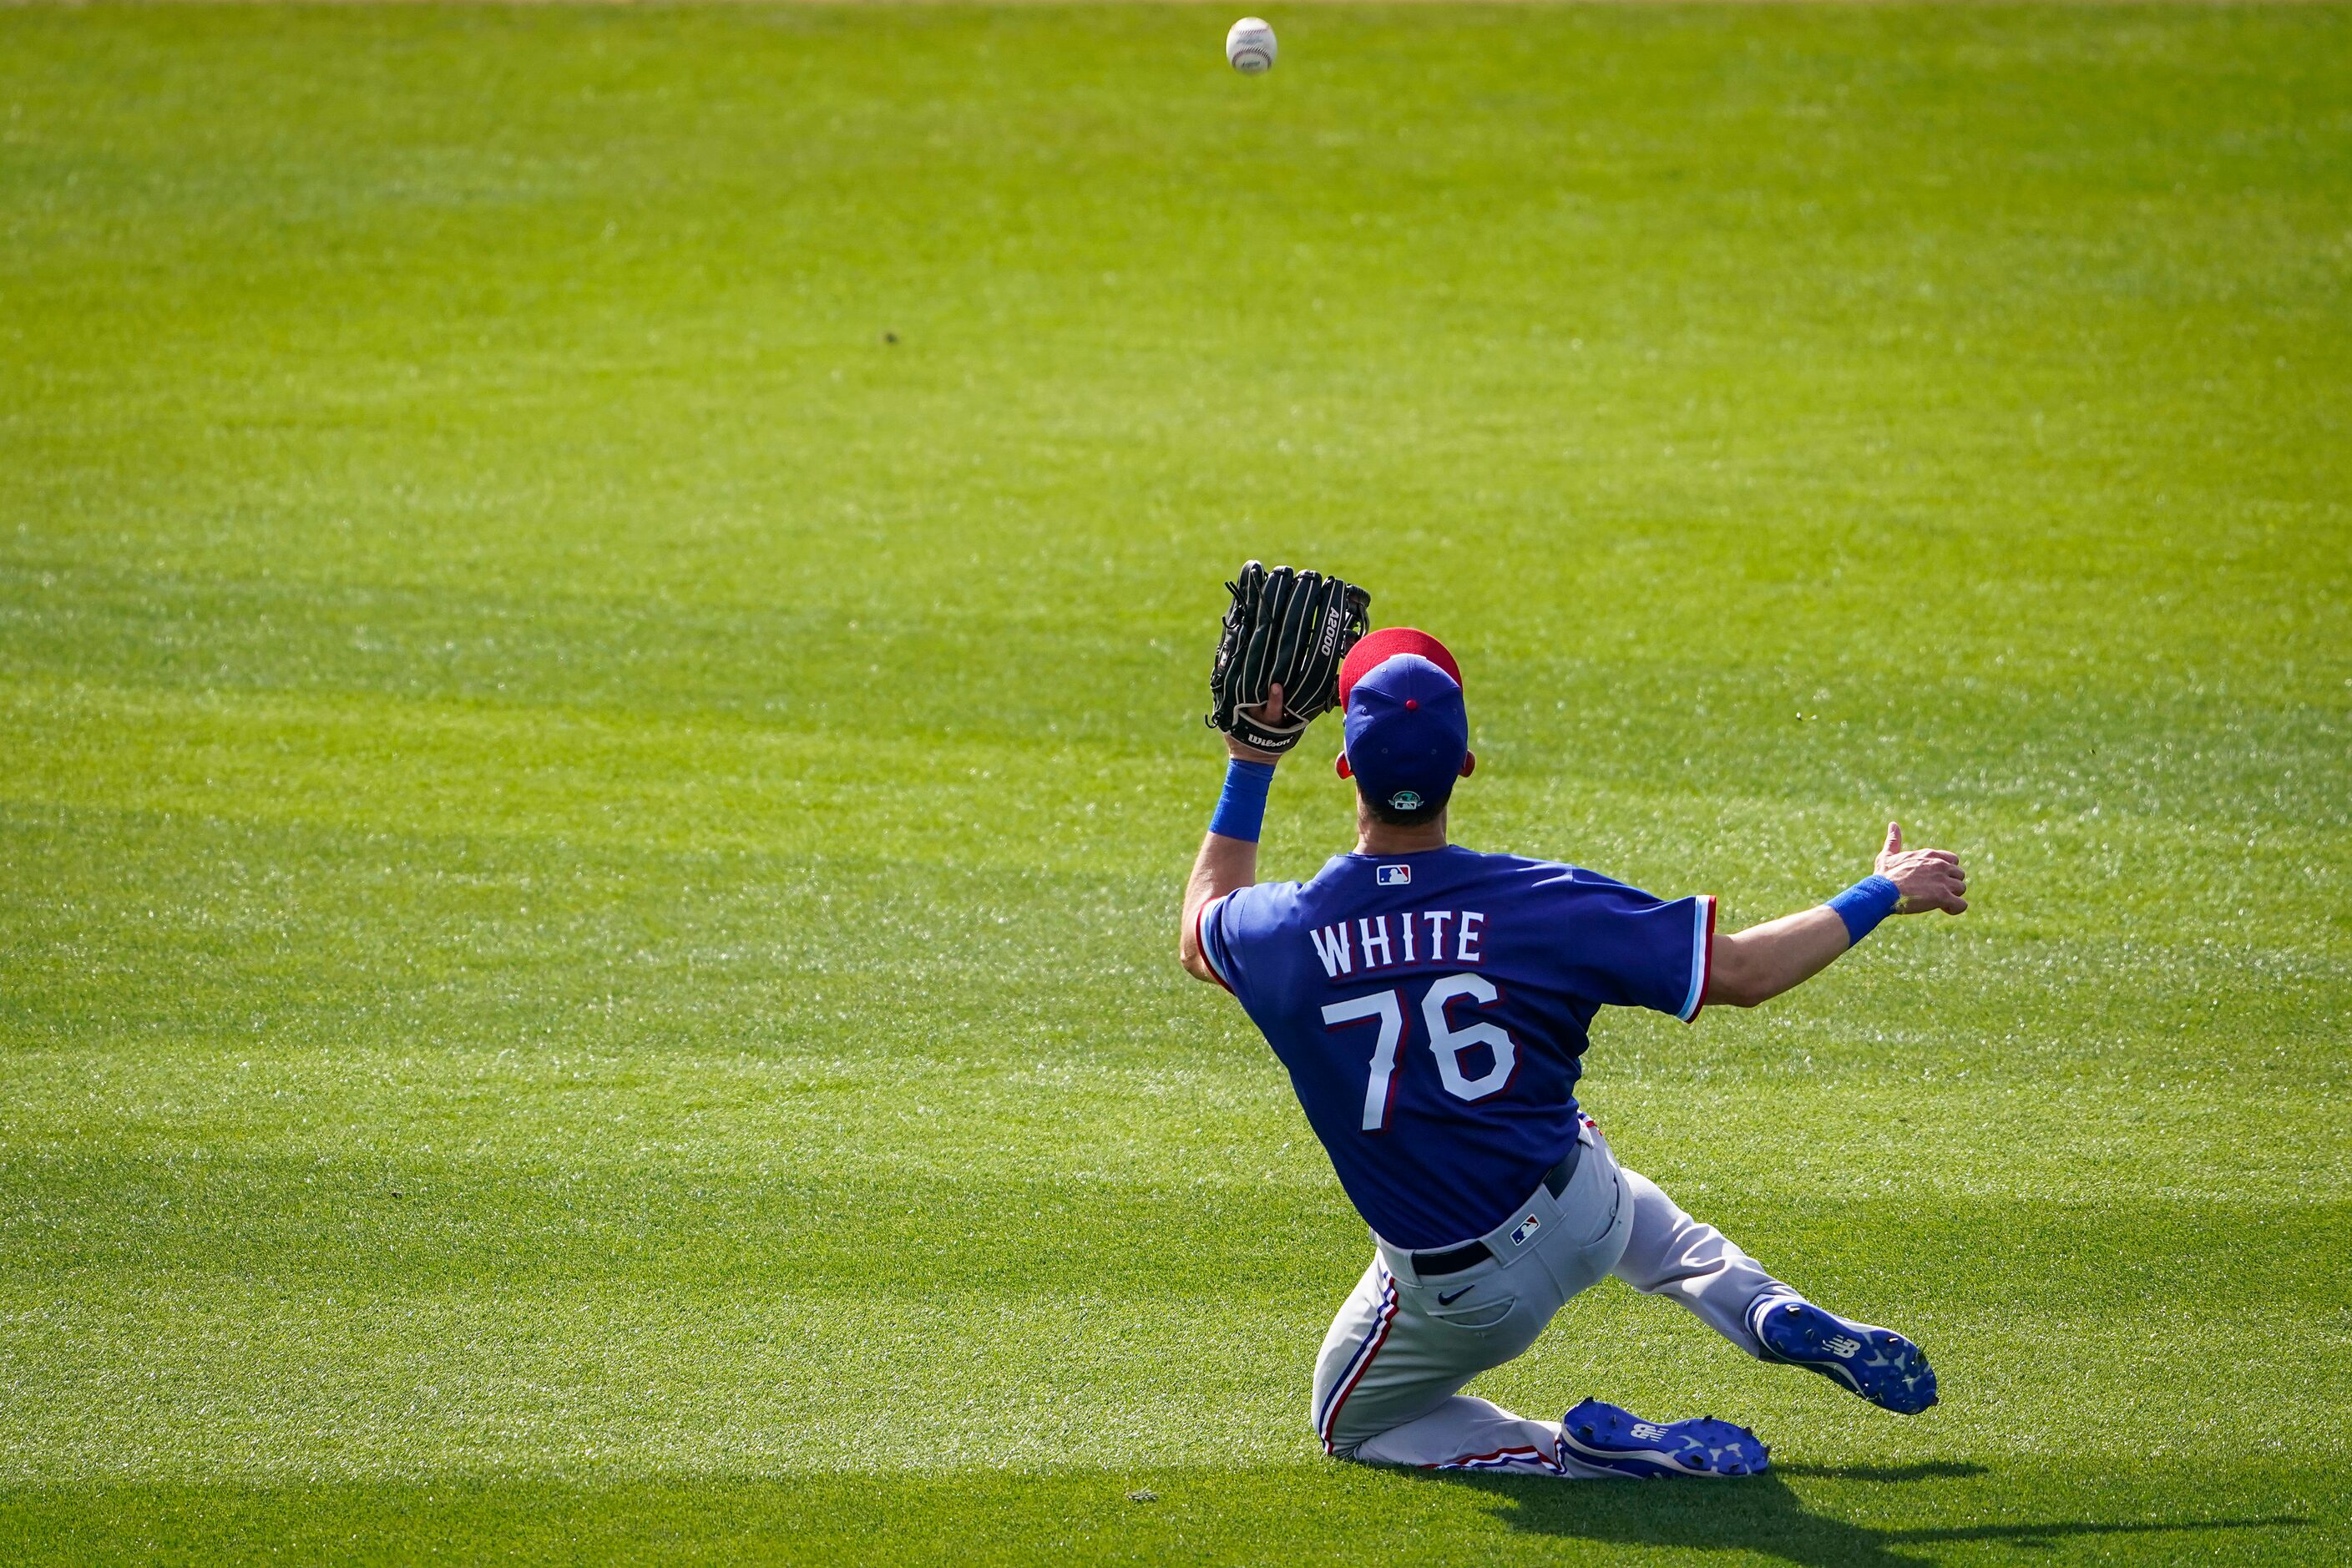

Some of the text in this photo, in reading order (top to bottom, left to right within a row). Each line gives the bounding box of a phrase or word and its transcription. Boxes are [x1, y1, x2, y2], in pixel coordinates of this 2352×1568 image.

[1322, 606, 1341, 657] A2000
[1247, 733, 1292, 748] Wilson
[1309, 911, 1485, 979] WHITE
[1320, 972, 1517, 1131] 76
